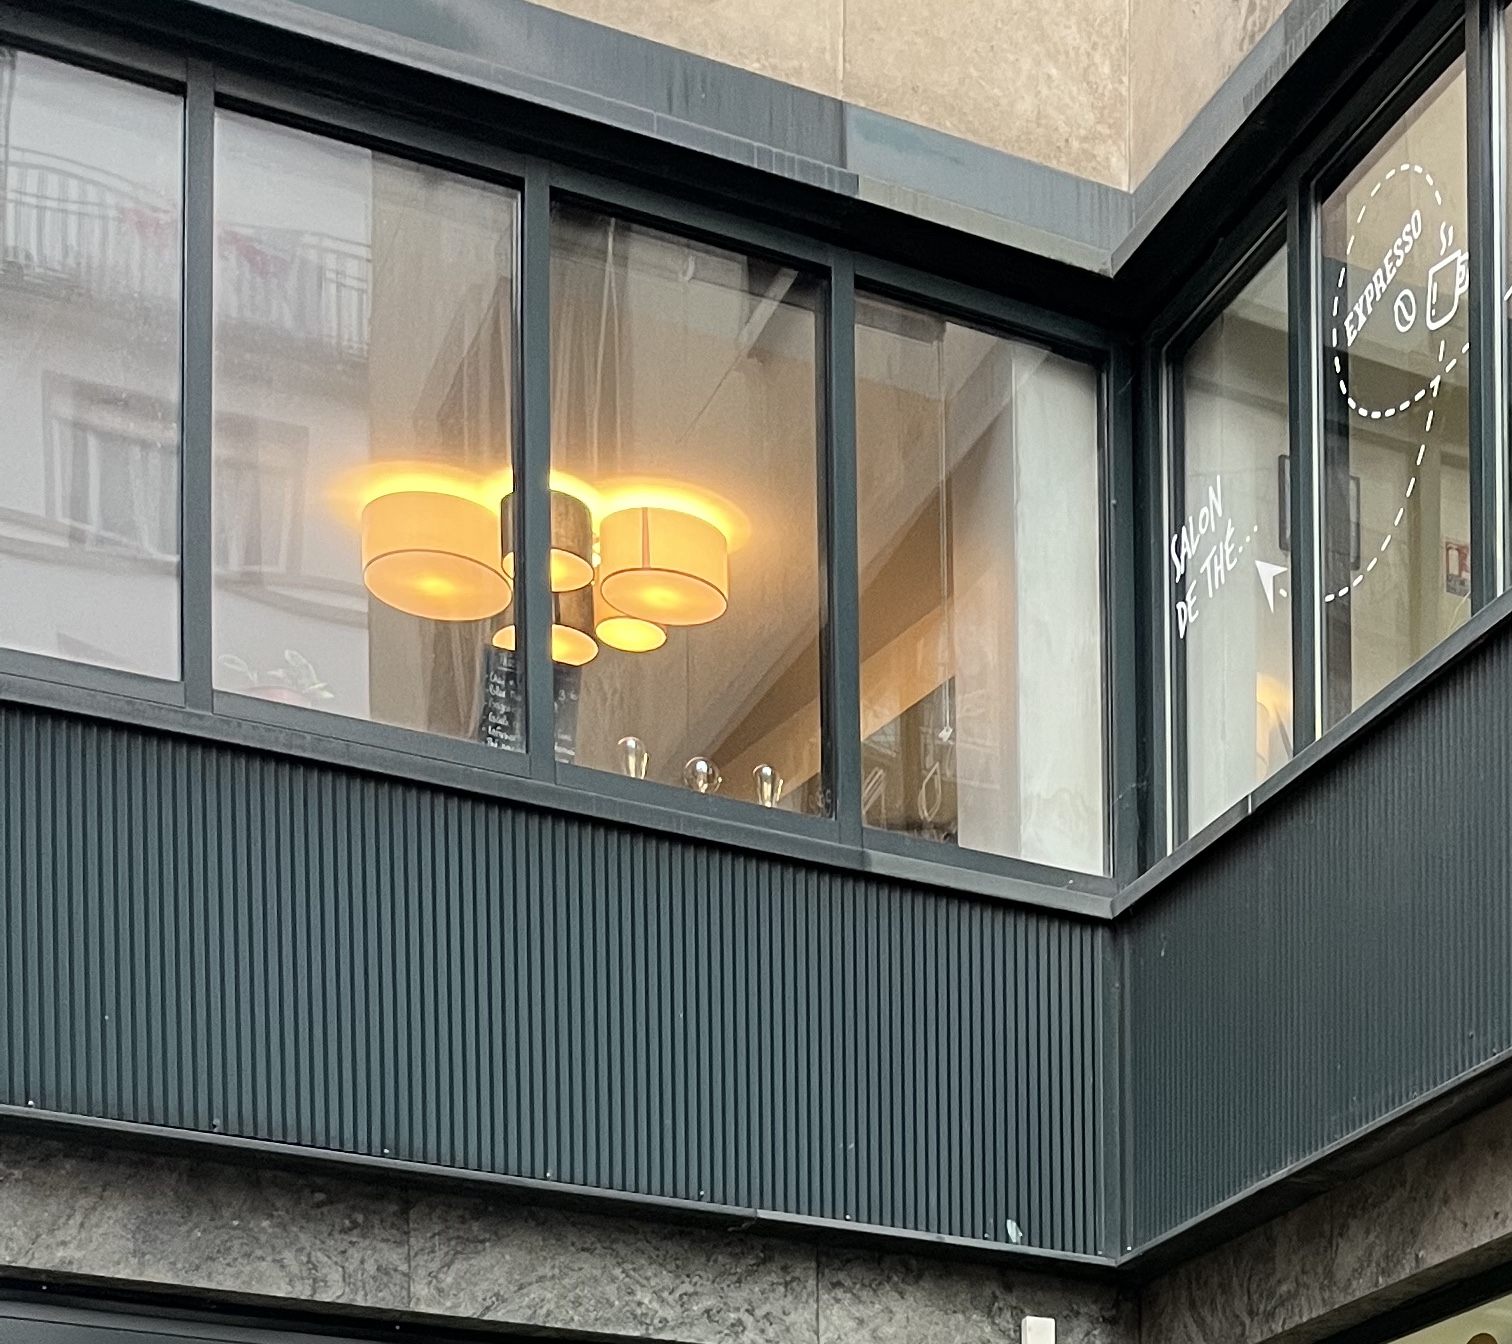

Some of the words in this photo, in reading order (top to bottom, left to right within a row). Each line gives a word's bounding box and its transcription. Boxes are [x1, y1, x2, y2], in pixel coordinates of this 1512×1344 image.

[1344, 209, 1422, 347] EXPRESSO
[1170, 474, 1223, 584] SALON
[1176, 579, 1199, 639] DE
